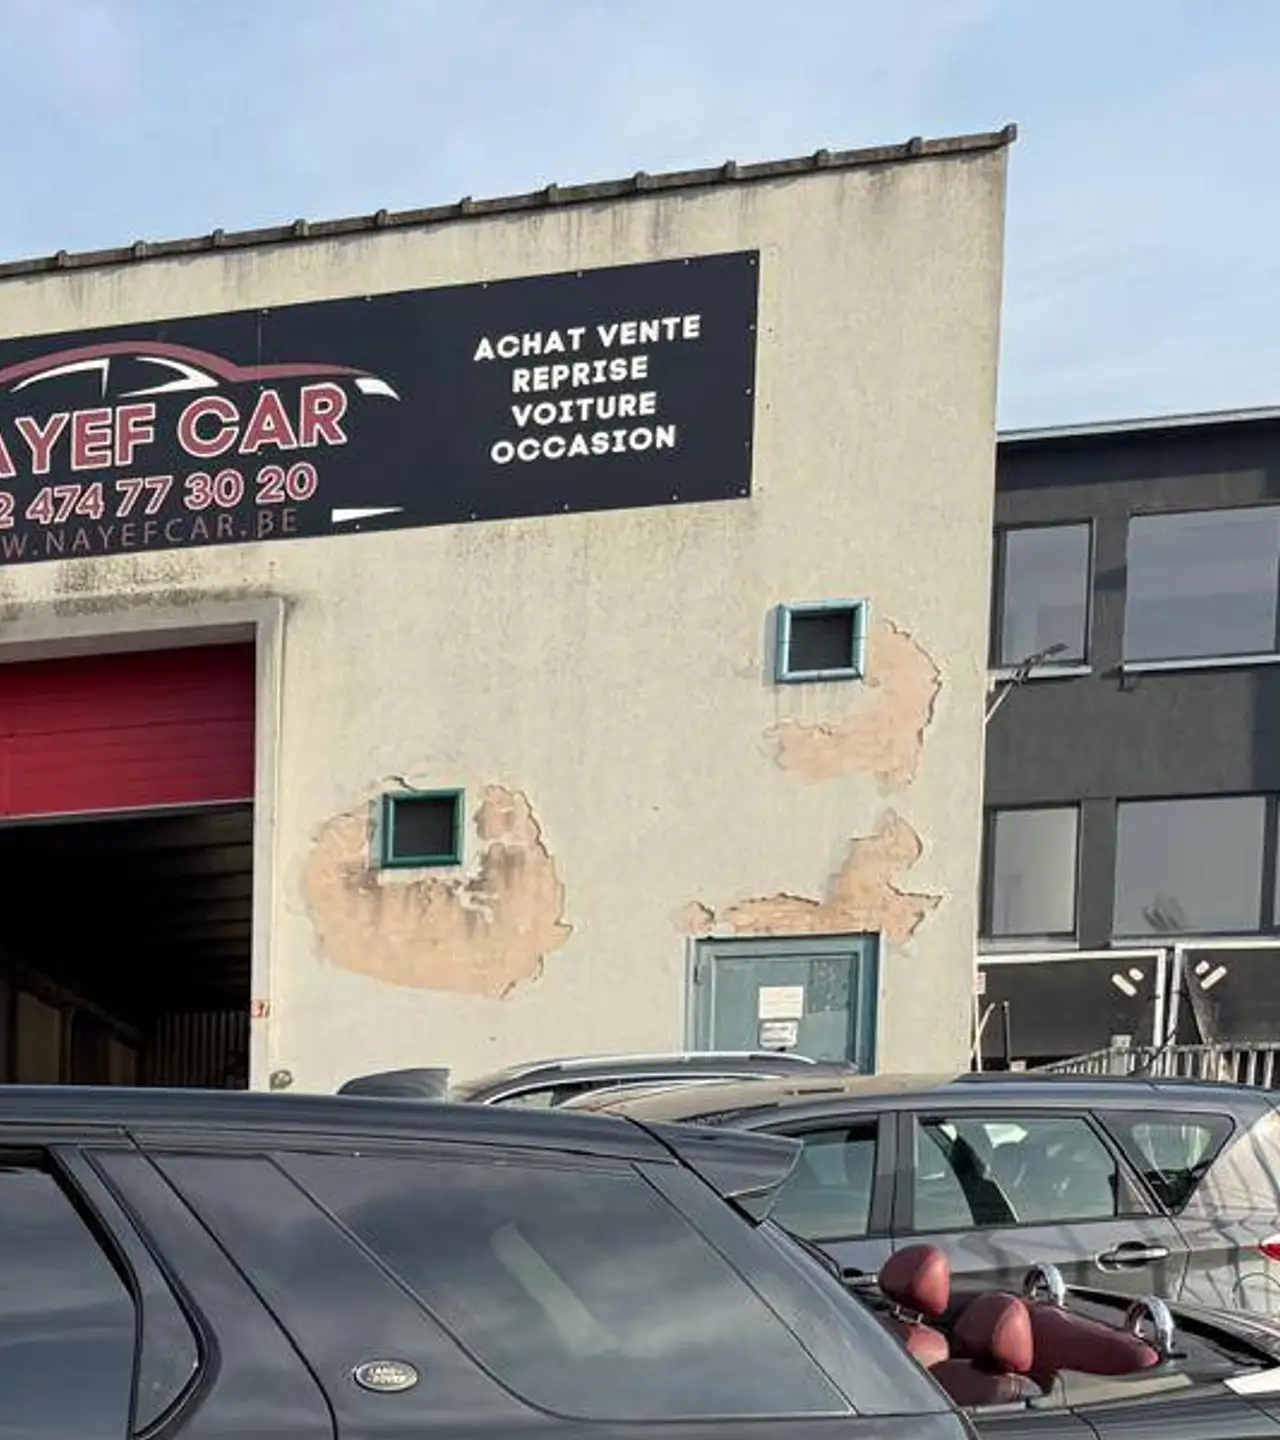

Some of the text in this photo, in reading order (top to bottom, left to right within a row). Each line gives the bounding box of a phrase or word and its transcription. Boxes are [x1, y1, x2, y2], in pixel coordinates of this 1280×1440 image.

[473, 314, 701, 361] ACHAT VENTE
[512, 355, 649, 393] REPRISE
[177, 382, 348, 457] CAR
[511, 392, 657, 427] VOITURE
[490, 425, 676, 464] OCCASION
[26, 482, 105, 525] 474
[116, 475, 174, 514] 77
[183, 468, 244, 510] 30
[256, 461, 318, 504] 20
